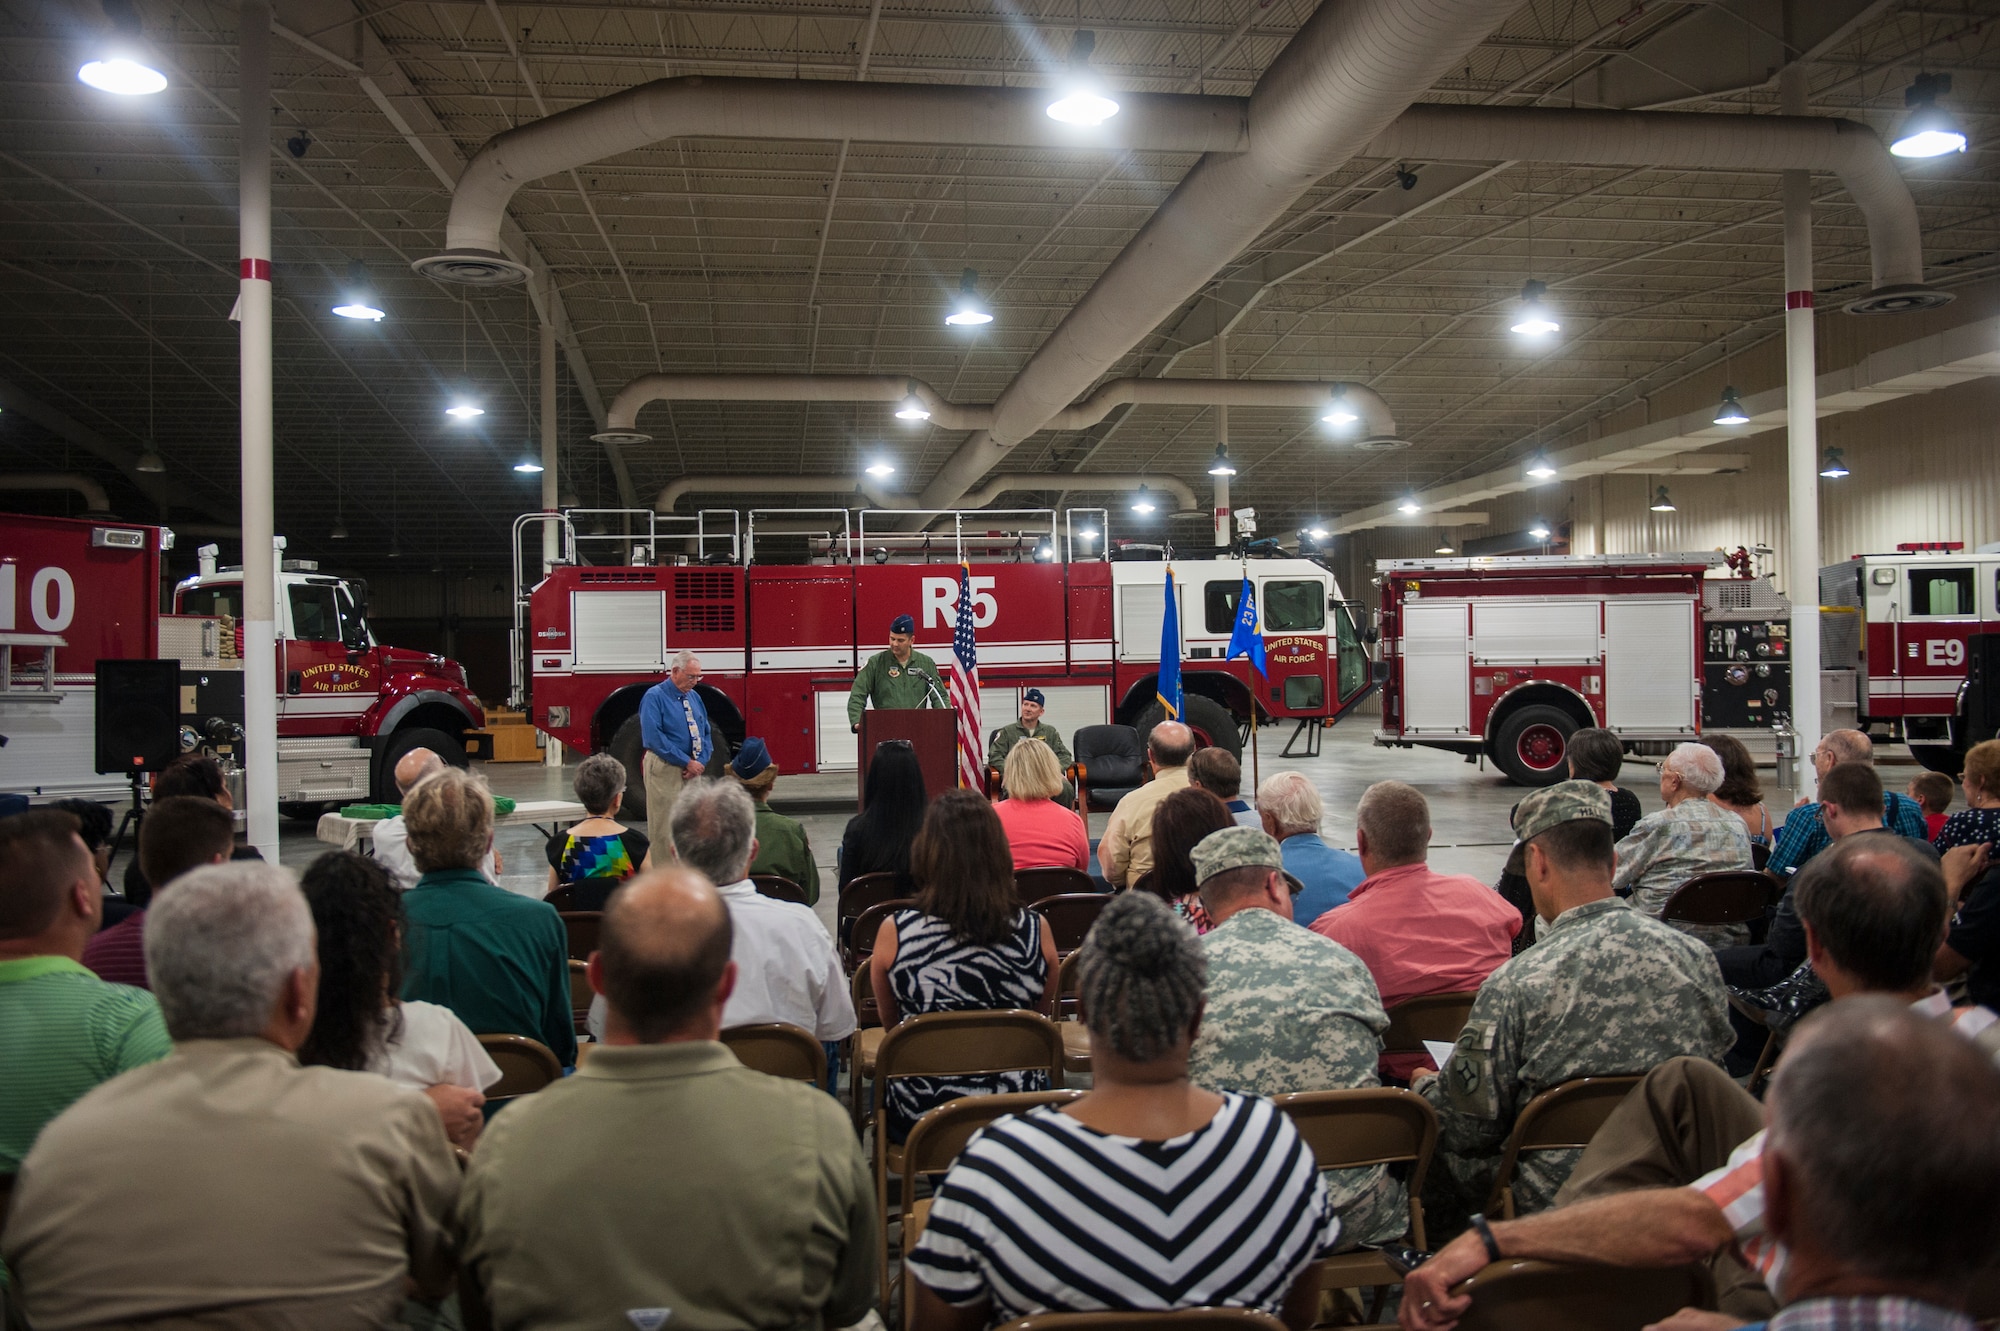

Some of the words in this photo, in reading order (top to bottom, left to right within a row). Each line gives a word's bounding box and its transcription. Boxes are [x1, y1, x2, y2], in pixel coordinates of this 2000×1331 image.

[922, 576, 997, 628] R5
[1264, 637, 1293, 653] UNITED
[1294, 637, 1324, 651] STATES
[1926, 639, 1964, 666] E9
[1273, 654, 1287, 663] AIR
[1288, 652, 1316, 664] FORCE
[302, 663, 336, 678] UNITED
[338, 663, 370, 679] STATES
[312, 681, 330, 692] AIR
[332, 680, 361, 692] FORCE
